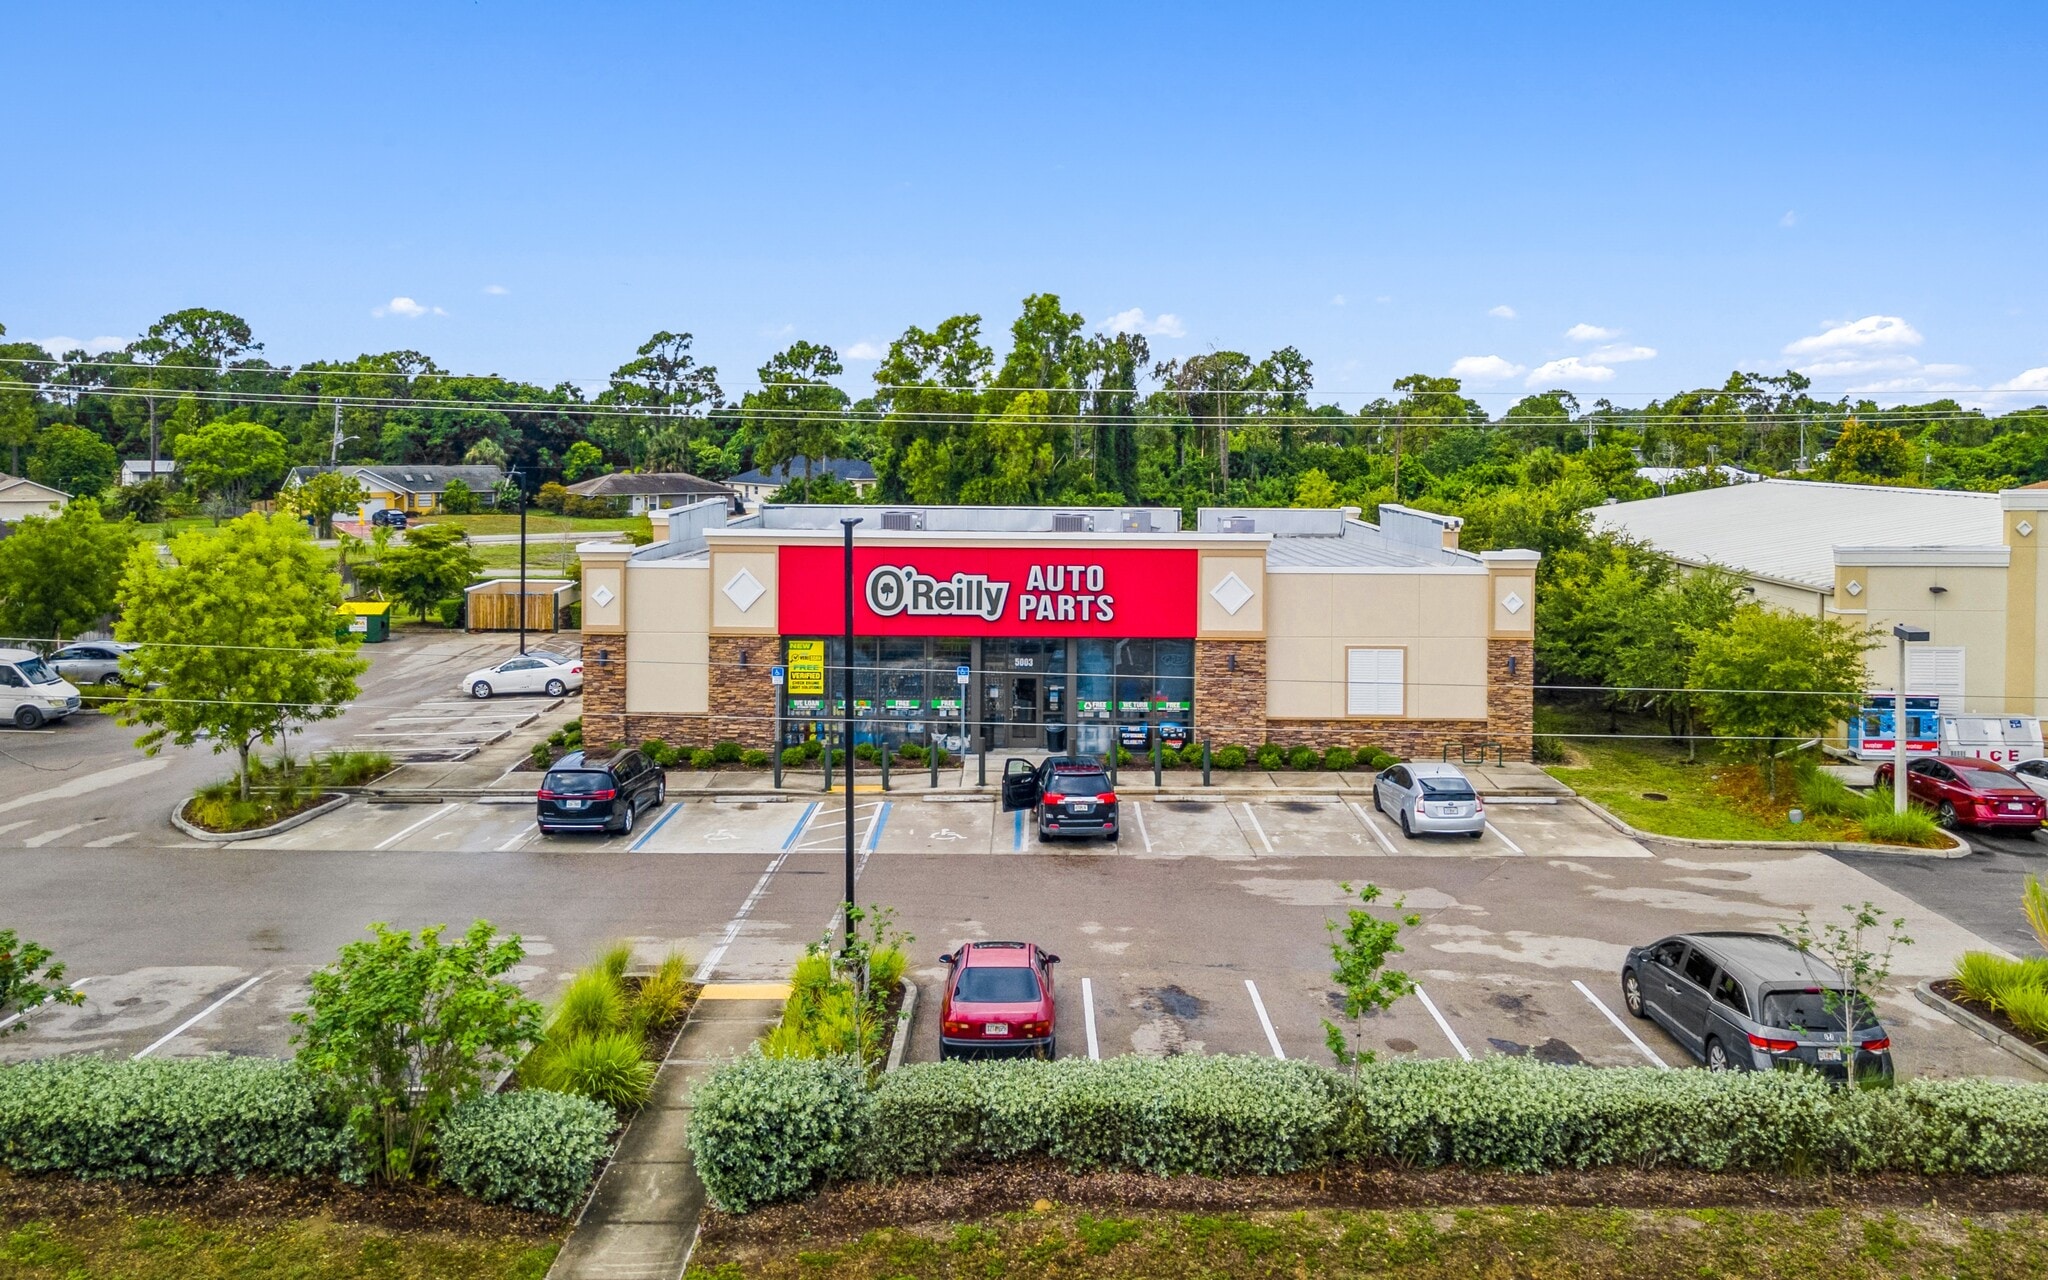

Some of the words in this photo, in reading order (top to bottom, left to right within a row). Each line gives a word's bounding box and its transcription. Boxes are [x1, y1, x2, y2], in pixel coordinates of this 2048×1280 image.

[1025, 565, 1104, 592] AUTO
[869, 569, 1004, 617] O'Reilly
[1019, 595, 1114, 621] PARTS
[790, 642, 811, 650] NEW
[1014, 657, 1034, 667] 5003
[1975, 749, 2019, 762] ICE
